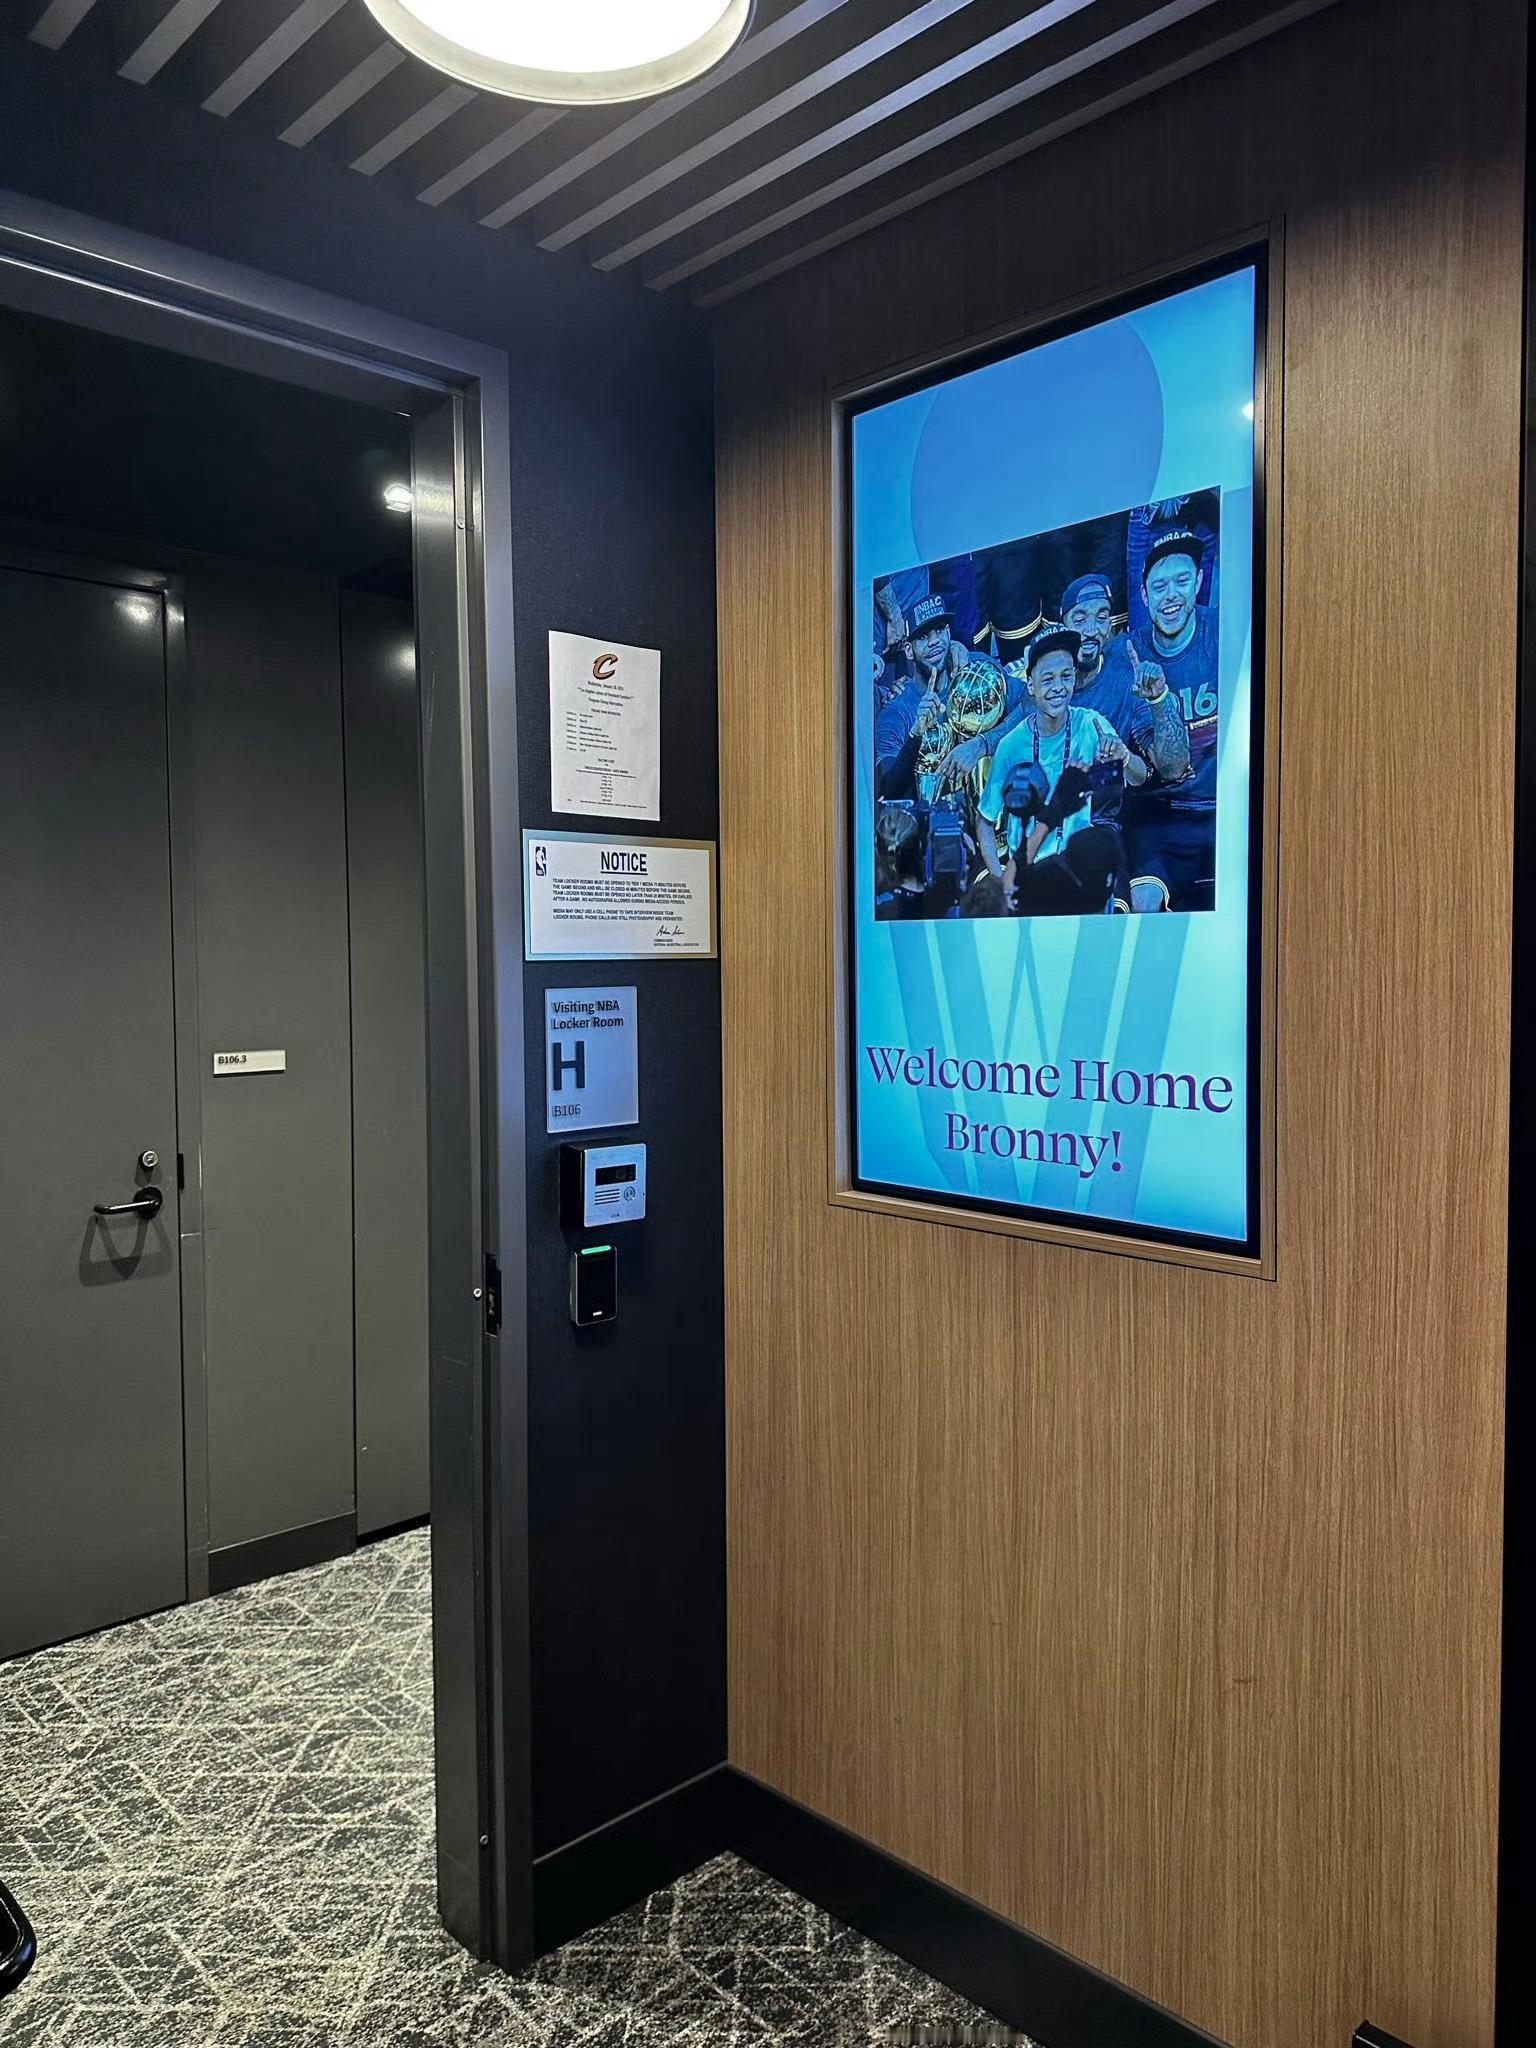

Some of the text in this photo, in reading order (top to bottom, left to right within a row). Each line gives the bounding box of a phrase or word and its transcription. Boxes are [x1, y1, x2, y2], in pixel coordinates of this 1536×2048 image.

[592, 654, 618, 680] C
[601, 851, 647, 872] NOTICE
[553, 1000, 620, 1014] Visiting NBA
[553, 1017, 624, 1030] Locker Room
[218, 1055, 247, 1064] B106.3
[552, 1041, 585, 1090] H
[865, 1046, 1233, 1113] Welcome Home
[553, 1104, 581, 1117] B106
[944, 1112, 1122, 1179] Bronny!
